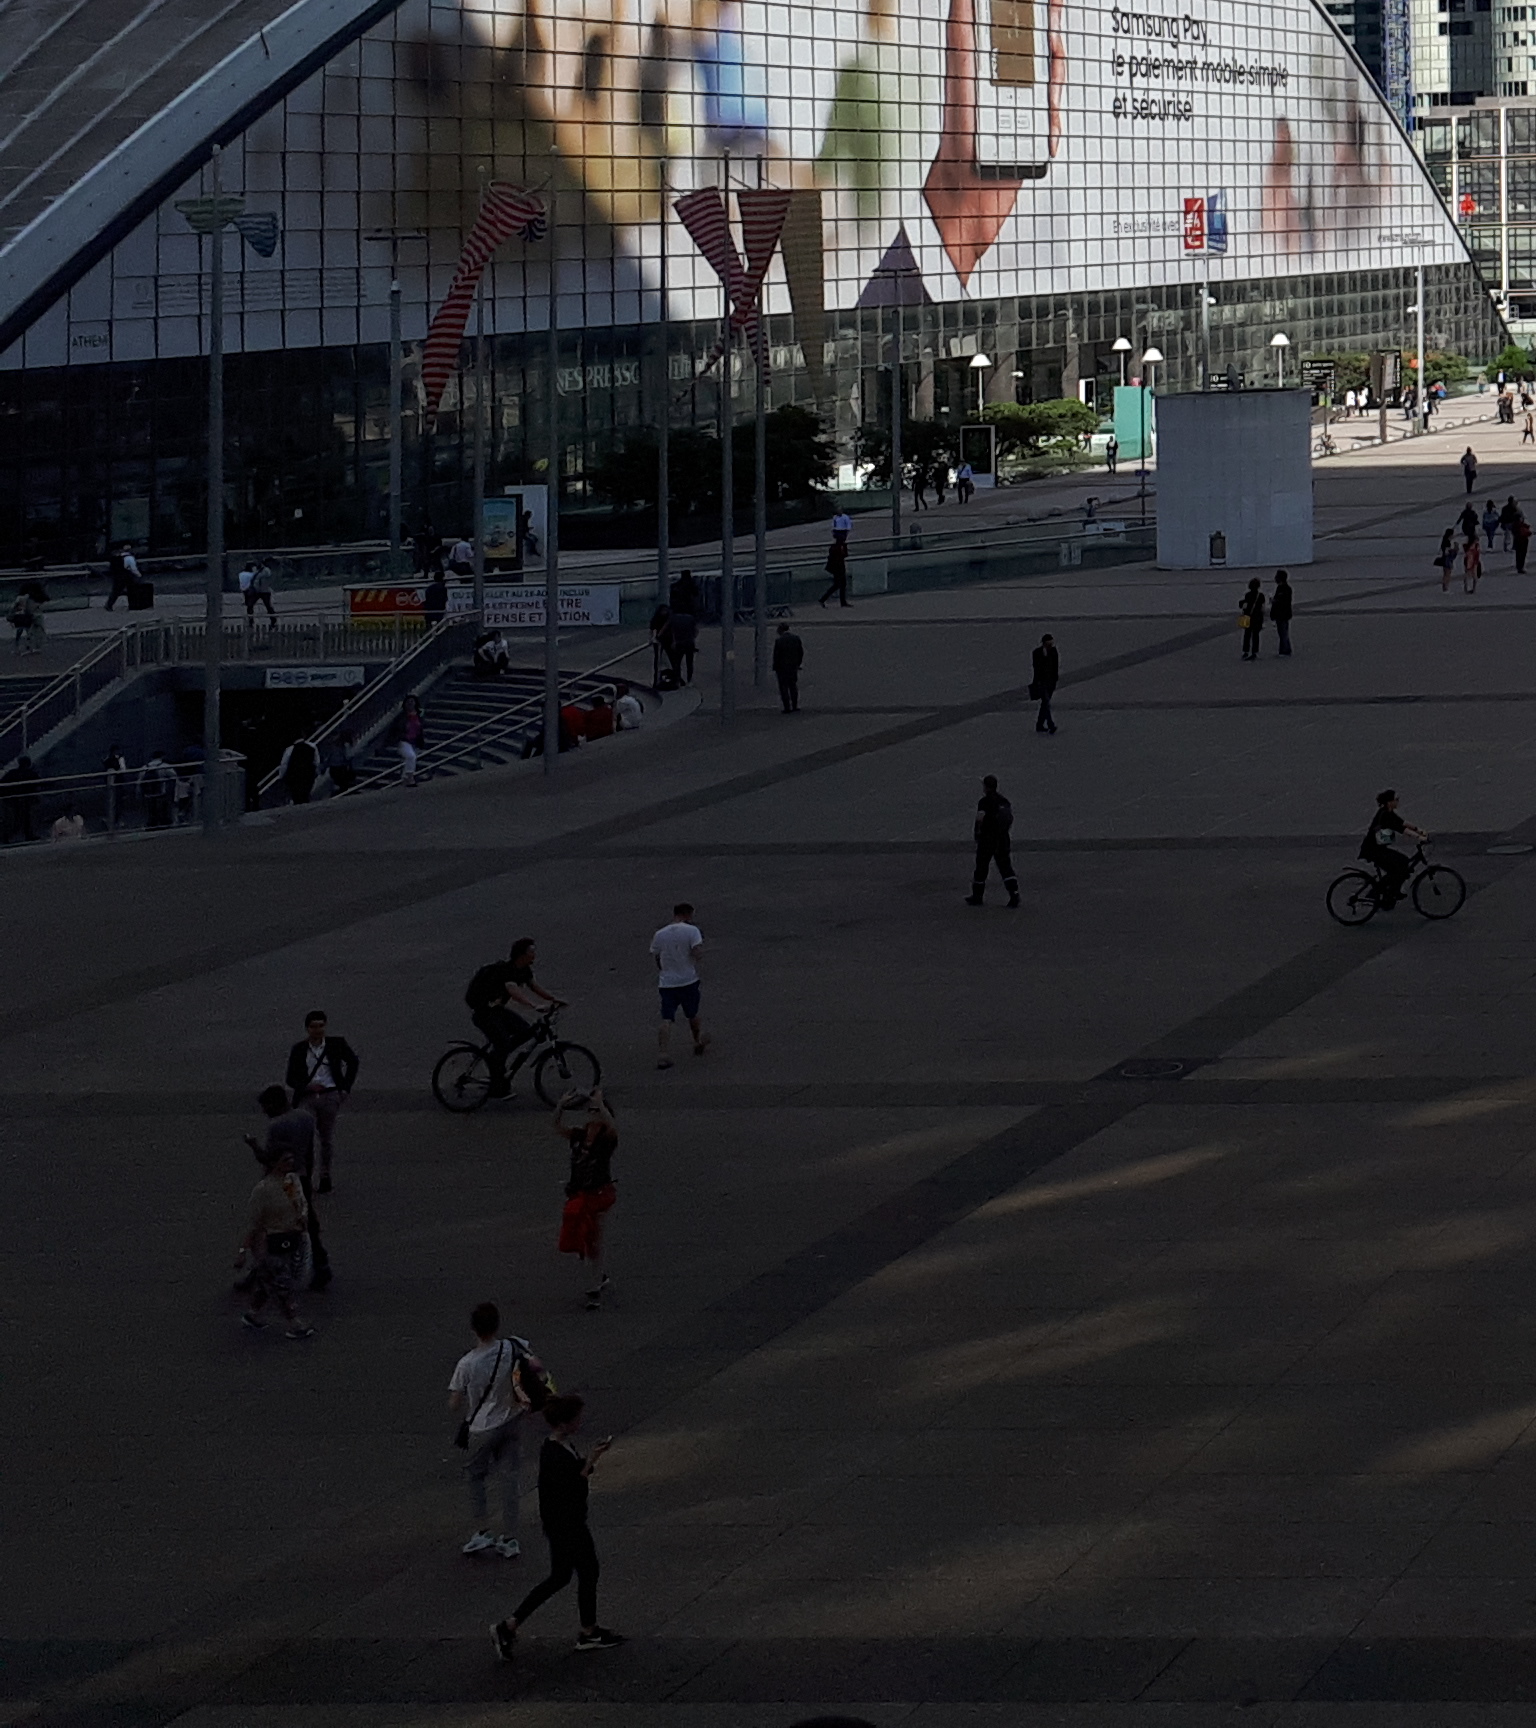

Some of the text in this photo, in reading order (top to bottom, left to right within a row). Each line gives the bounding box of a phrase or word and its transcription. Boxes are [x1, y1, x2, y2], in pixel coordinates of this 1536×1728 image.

[1111, 5, 1179, 49] Samsung
[1111, 48, 1289, 95] le paiement mobile simple
[1112, 90, 1193, 122] et sécurisé
